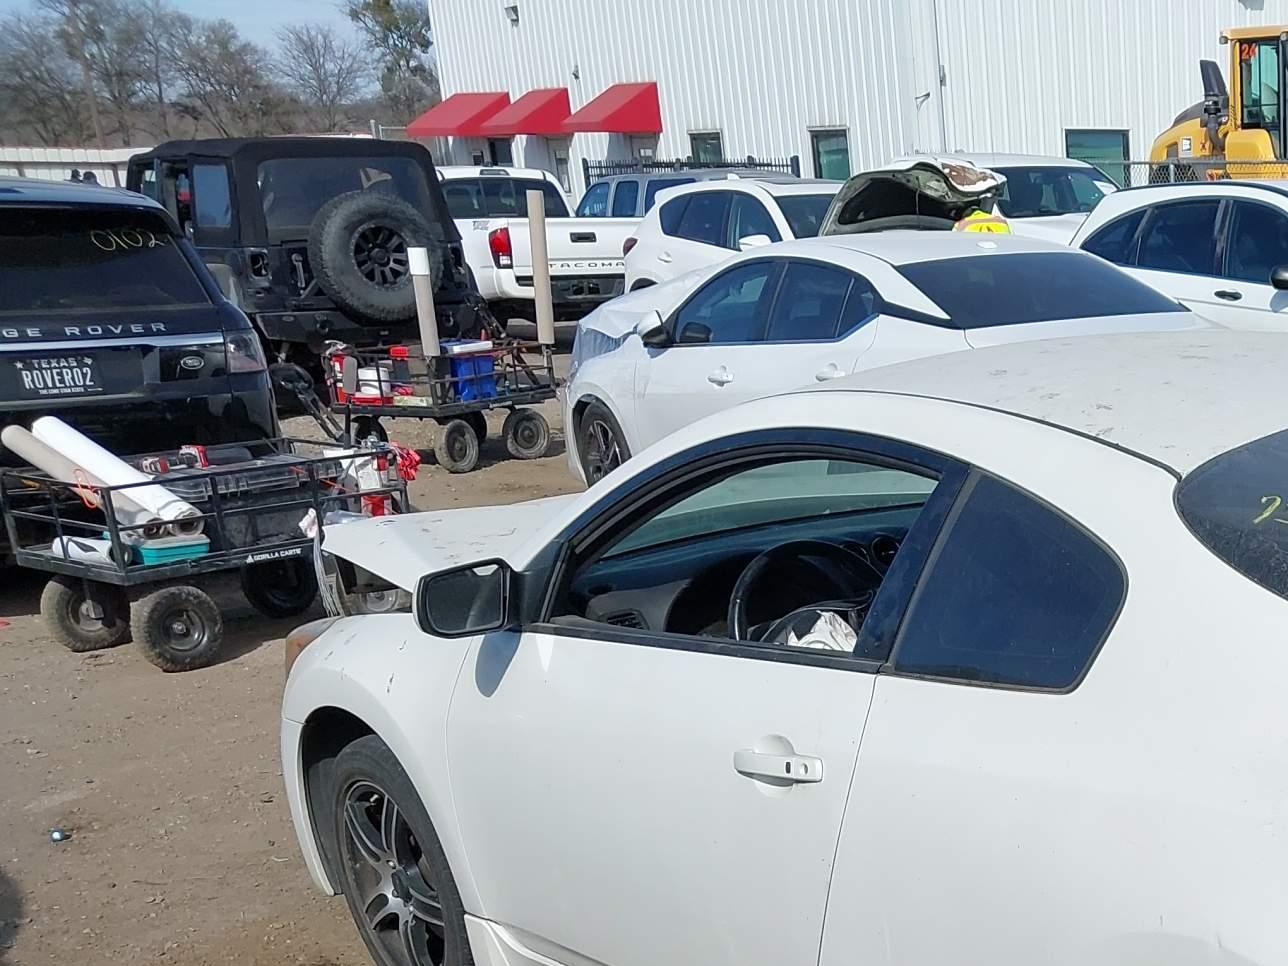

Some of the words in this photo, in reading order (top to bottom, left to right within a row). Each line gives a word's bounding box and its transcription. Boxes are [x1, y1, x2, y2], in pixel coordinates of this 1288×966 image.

[548, 261, 625, 269] TACOMA
[64, 322, 167, 336] ROVER
[32, 357, 77, 369] TEXAS
[21, 367, 95, 389] ROVER02
